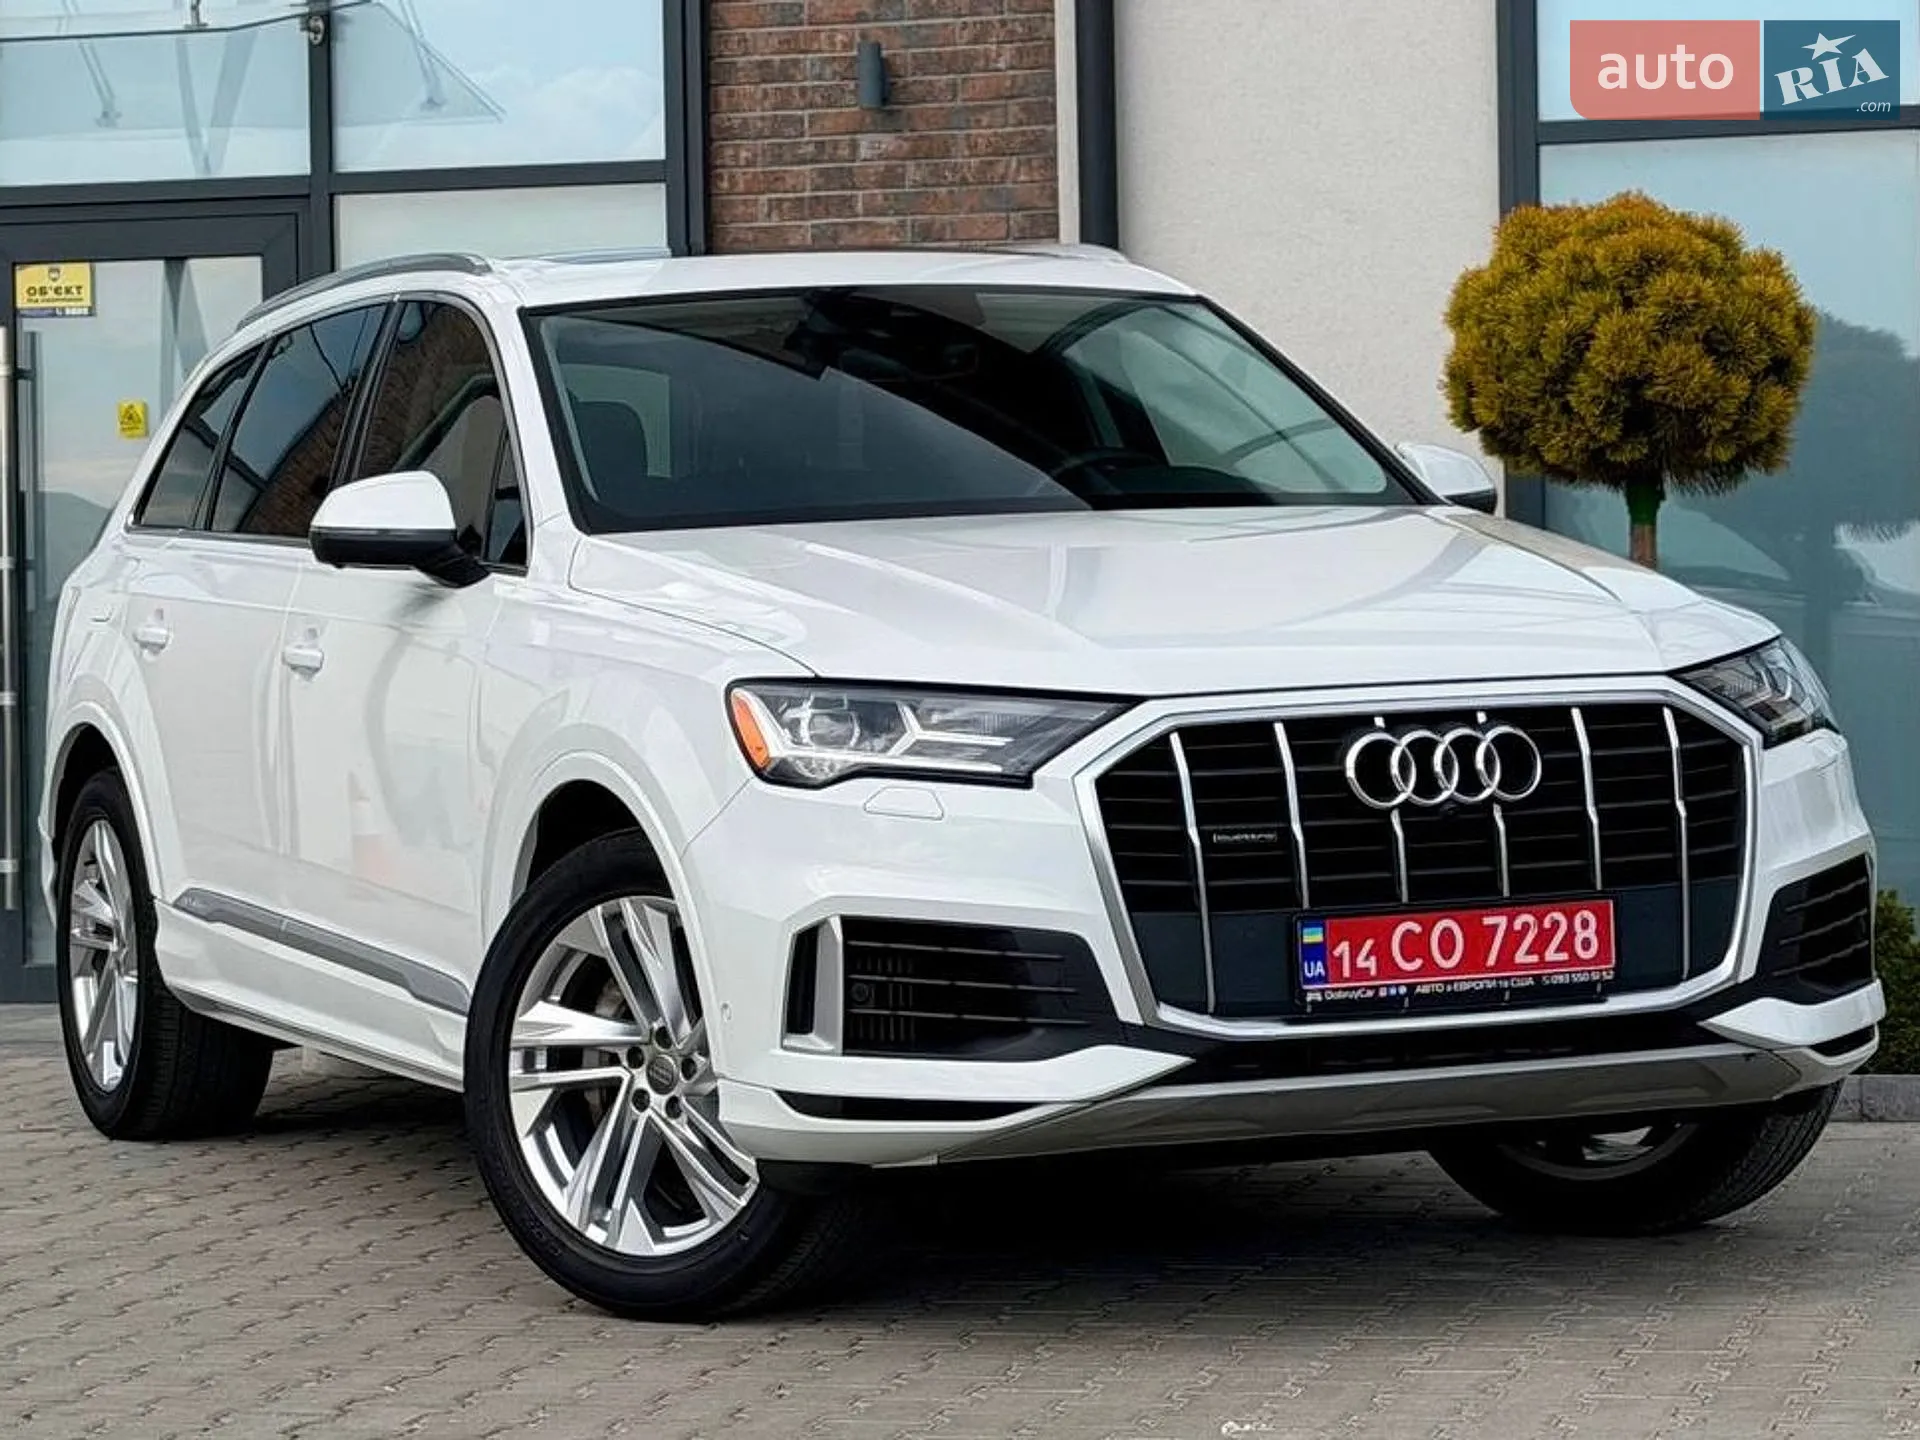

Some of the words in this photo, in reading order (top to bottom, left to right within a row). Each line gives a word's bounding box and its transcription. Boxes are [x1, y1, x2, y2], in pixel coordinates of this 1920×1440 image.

[26, 285, 83, 297] ОБ'ЄКТ
[1332, 938, 1378, 979] 14
[1390, 918, 1465, 972] CO
[1482, 909, 1600, 968] 7228
[1304, 959, 1326, 978] UA
